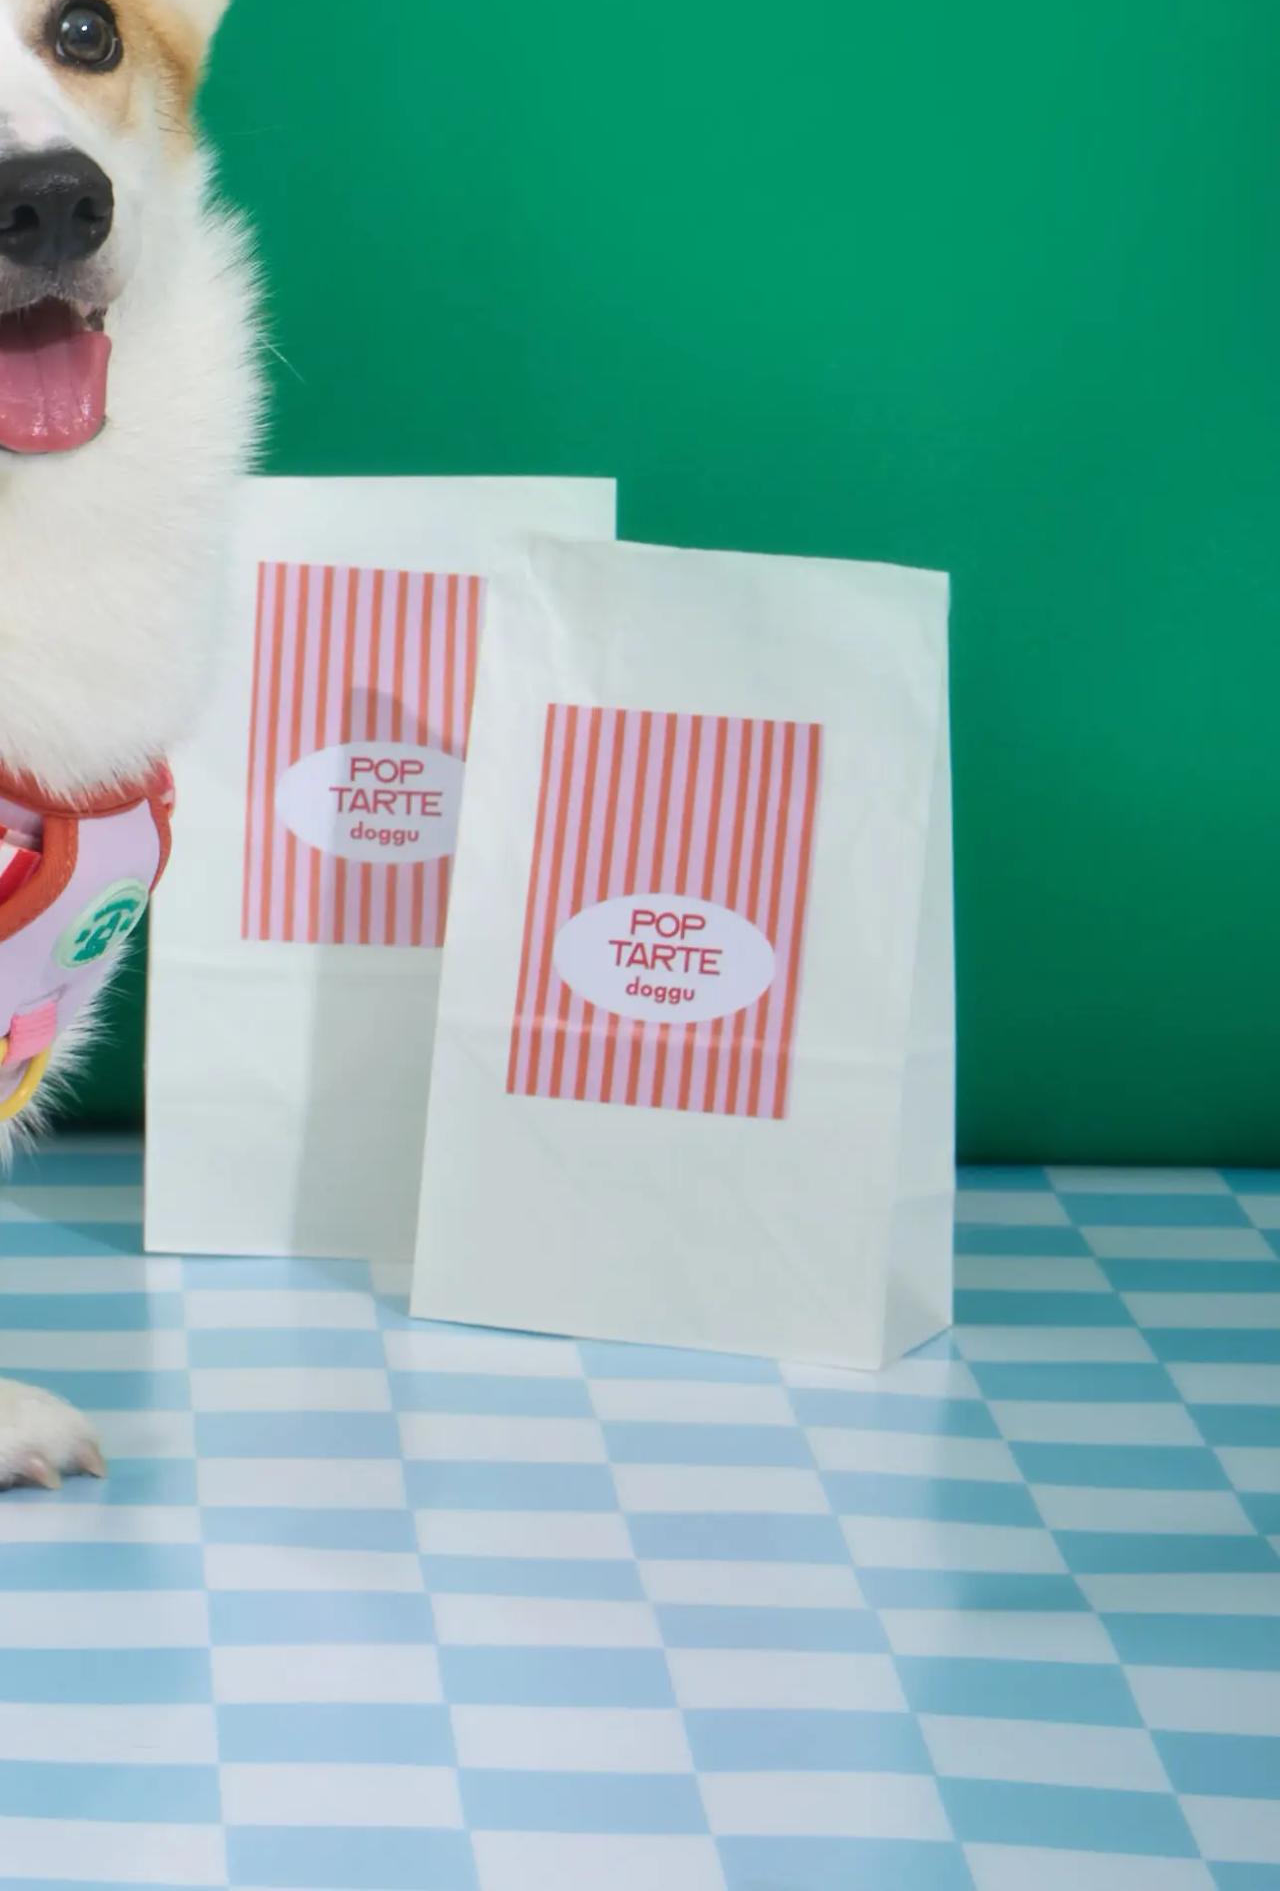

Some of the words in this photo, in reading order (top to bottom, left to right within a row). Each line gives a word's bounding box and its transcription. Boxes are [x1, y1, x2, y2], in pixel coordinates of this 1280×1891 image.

[349, 755, 425, 784] POP
[329, 785, 443, 816] TARTE
[349, 821, 420, 846] doggu
[629, 908, 706, 940] POP
[608, 939, 723, 976] TARTE
[625, 976, 695, 1004] doggu
